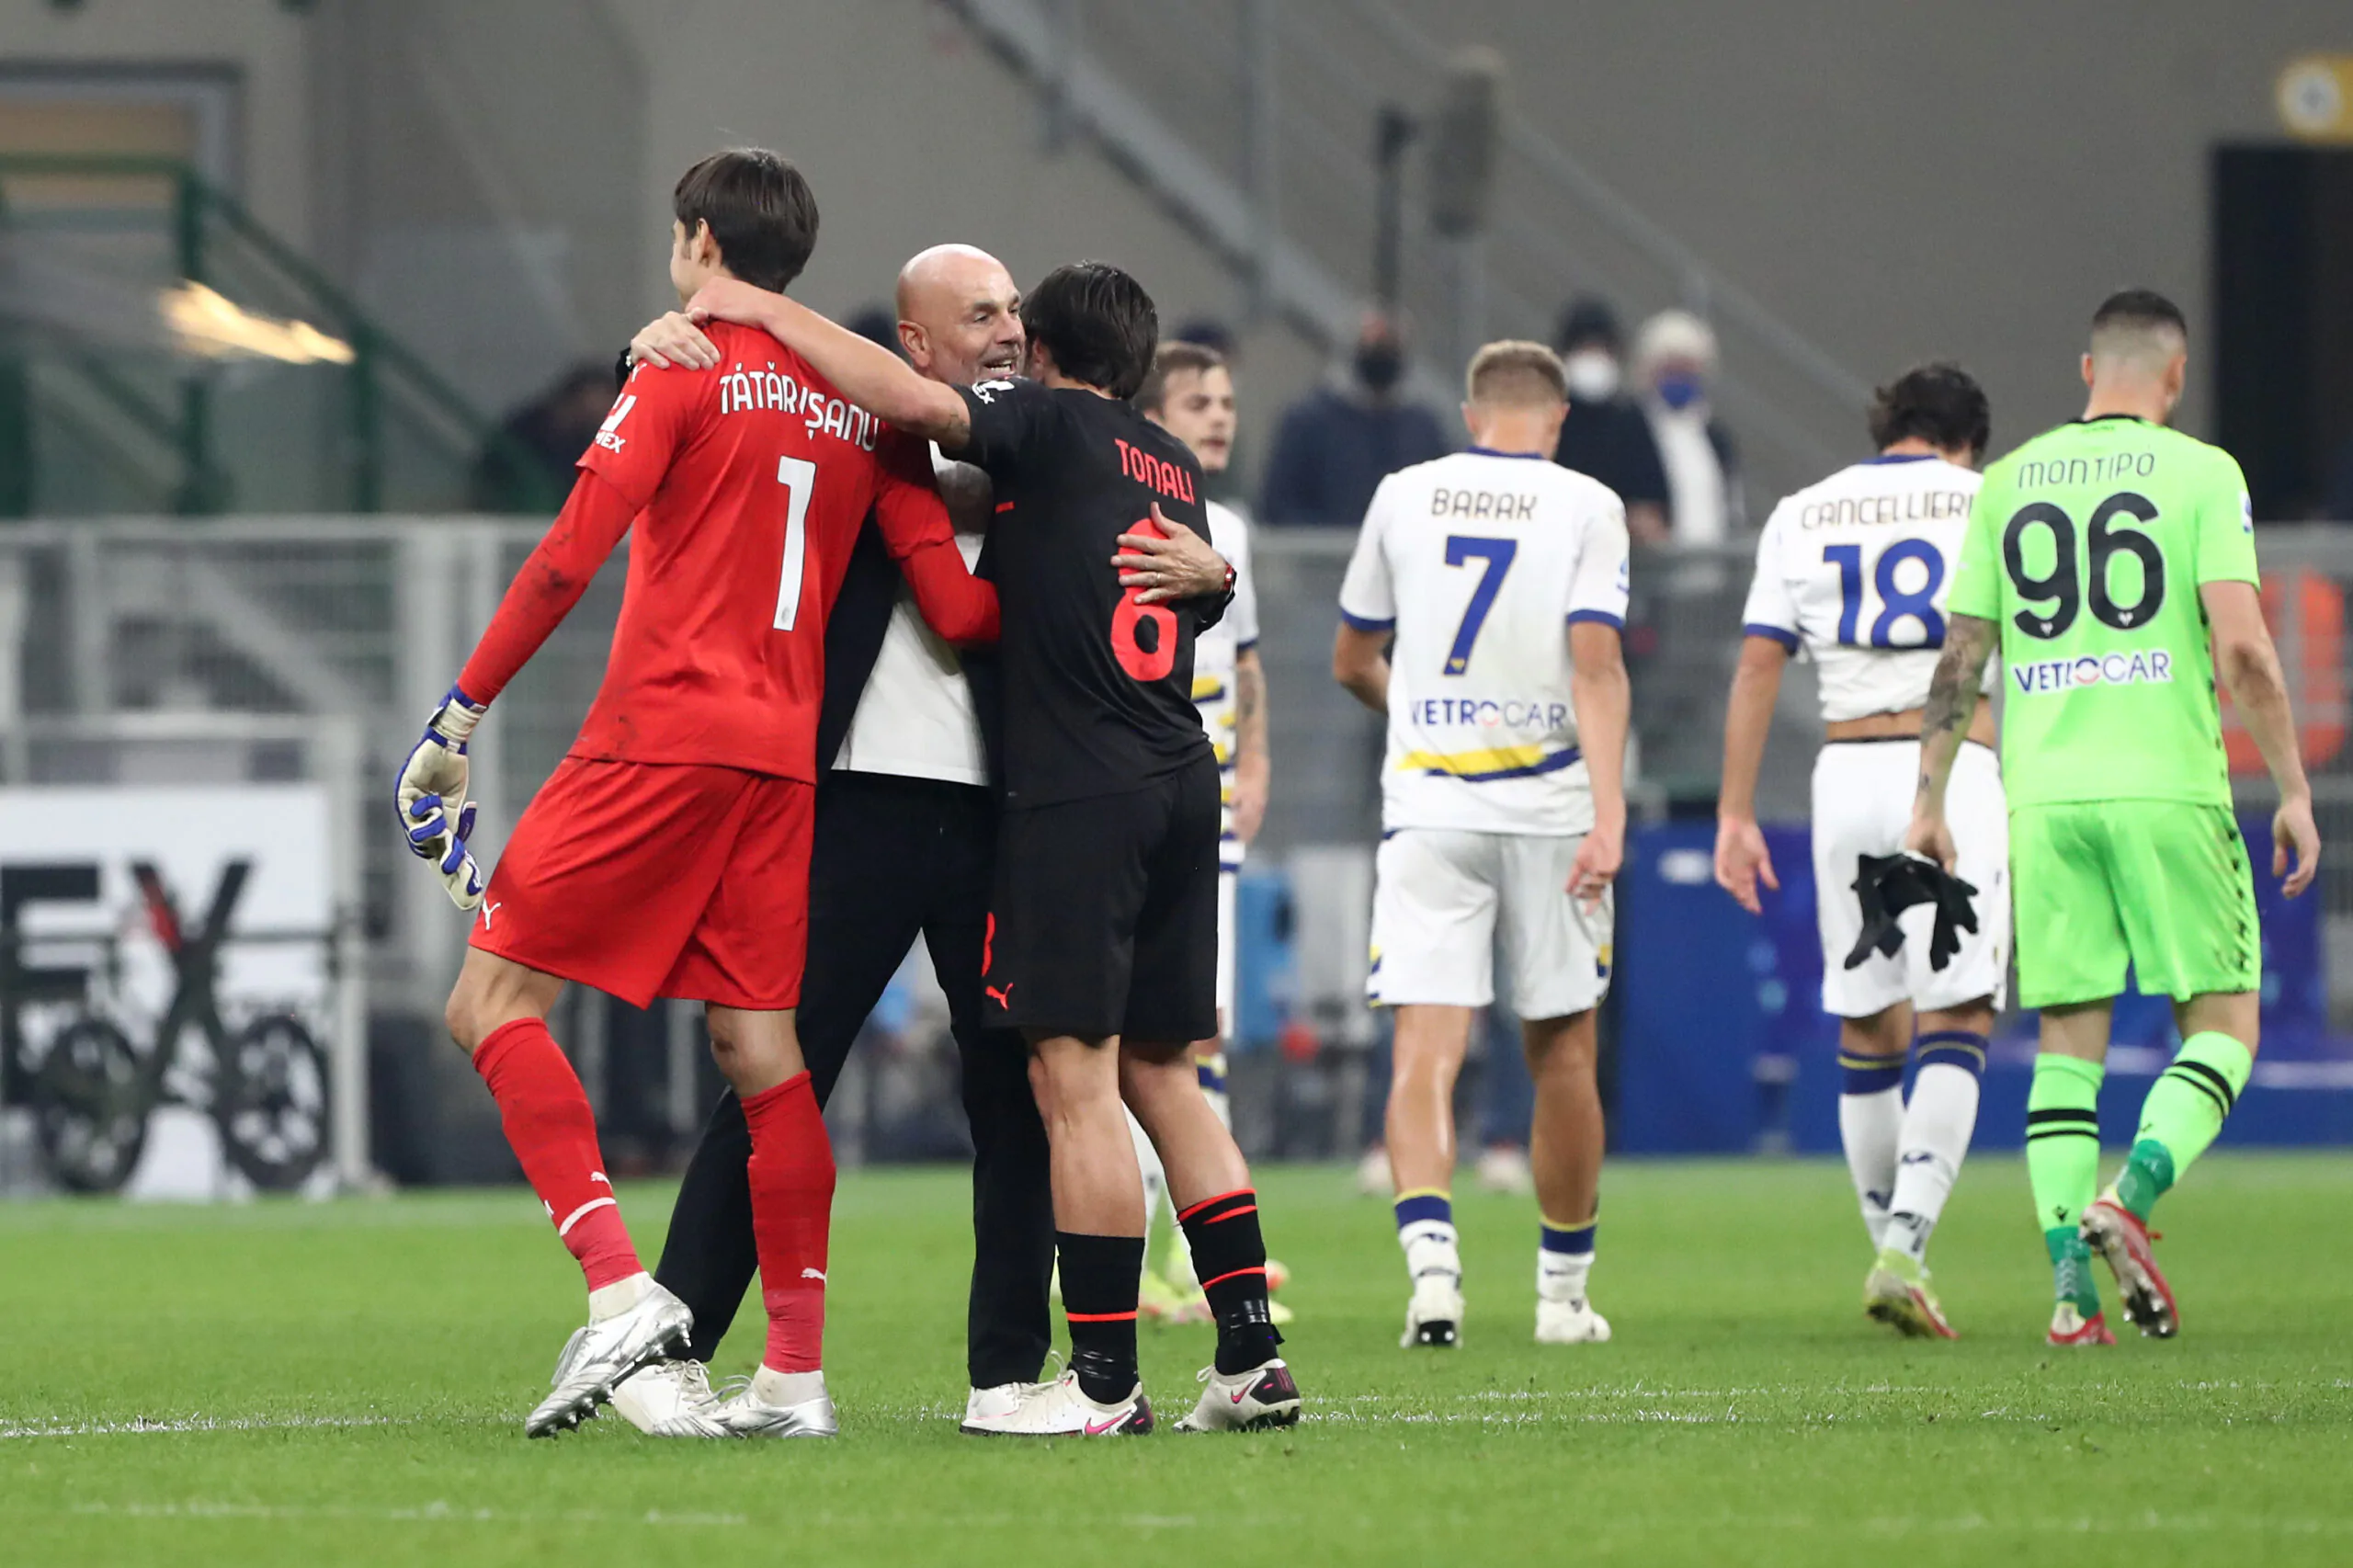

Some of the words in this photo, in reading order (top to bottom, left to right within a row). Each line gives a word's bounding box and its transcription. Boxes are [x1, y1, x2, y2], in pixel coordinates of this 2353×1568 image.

[1114, 437, 1195, 506] TONALI
[1431, 487, 1537, 521] BARAK
[776, 456, 816, 631] 1
[1444, 535, 1518, 677] 7
[1823, 538, 1946, 649] 18
[2003, 492, 2165, 640] 96
